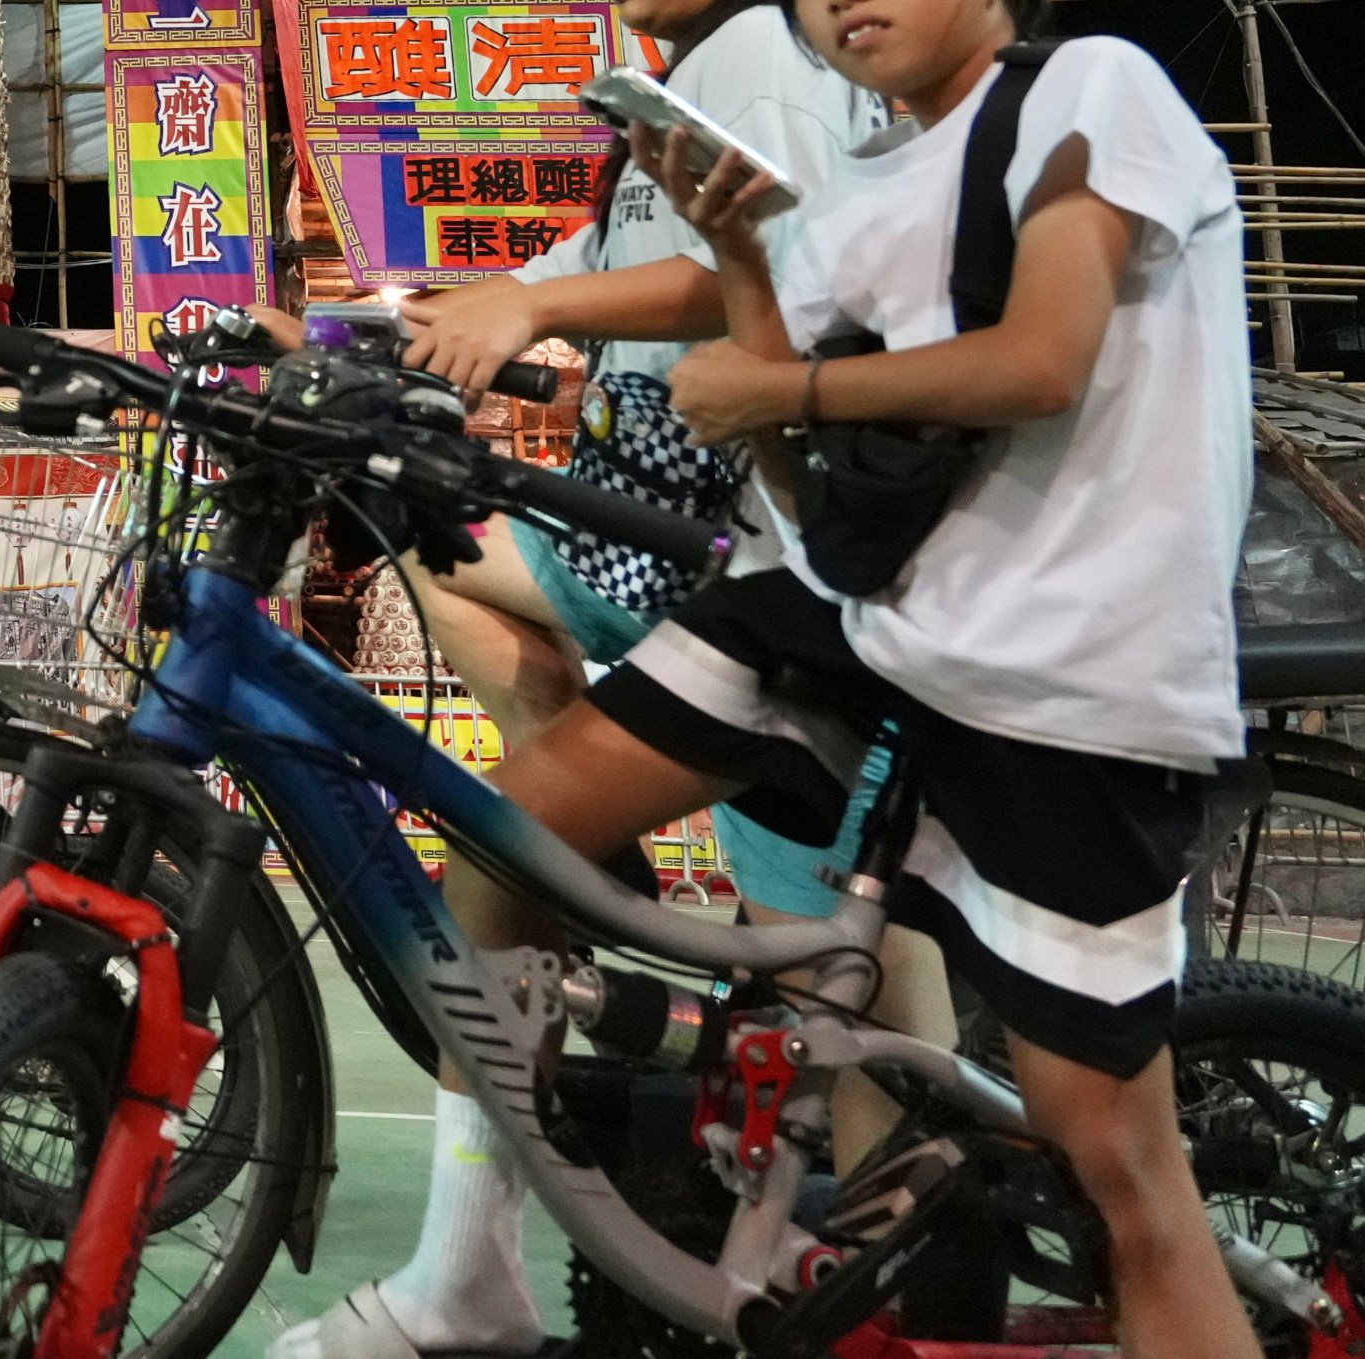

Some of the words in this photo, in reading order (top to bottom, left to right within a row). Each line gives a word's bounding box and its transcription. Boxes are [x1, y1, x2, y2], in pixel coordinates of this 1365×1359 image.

[317, 17, 667, 101] 清醮
[405, 157, 606, 205] 醮總理
